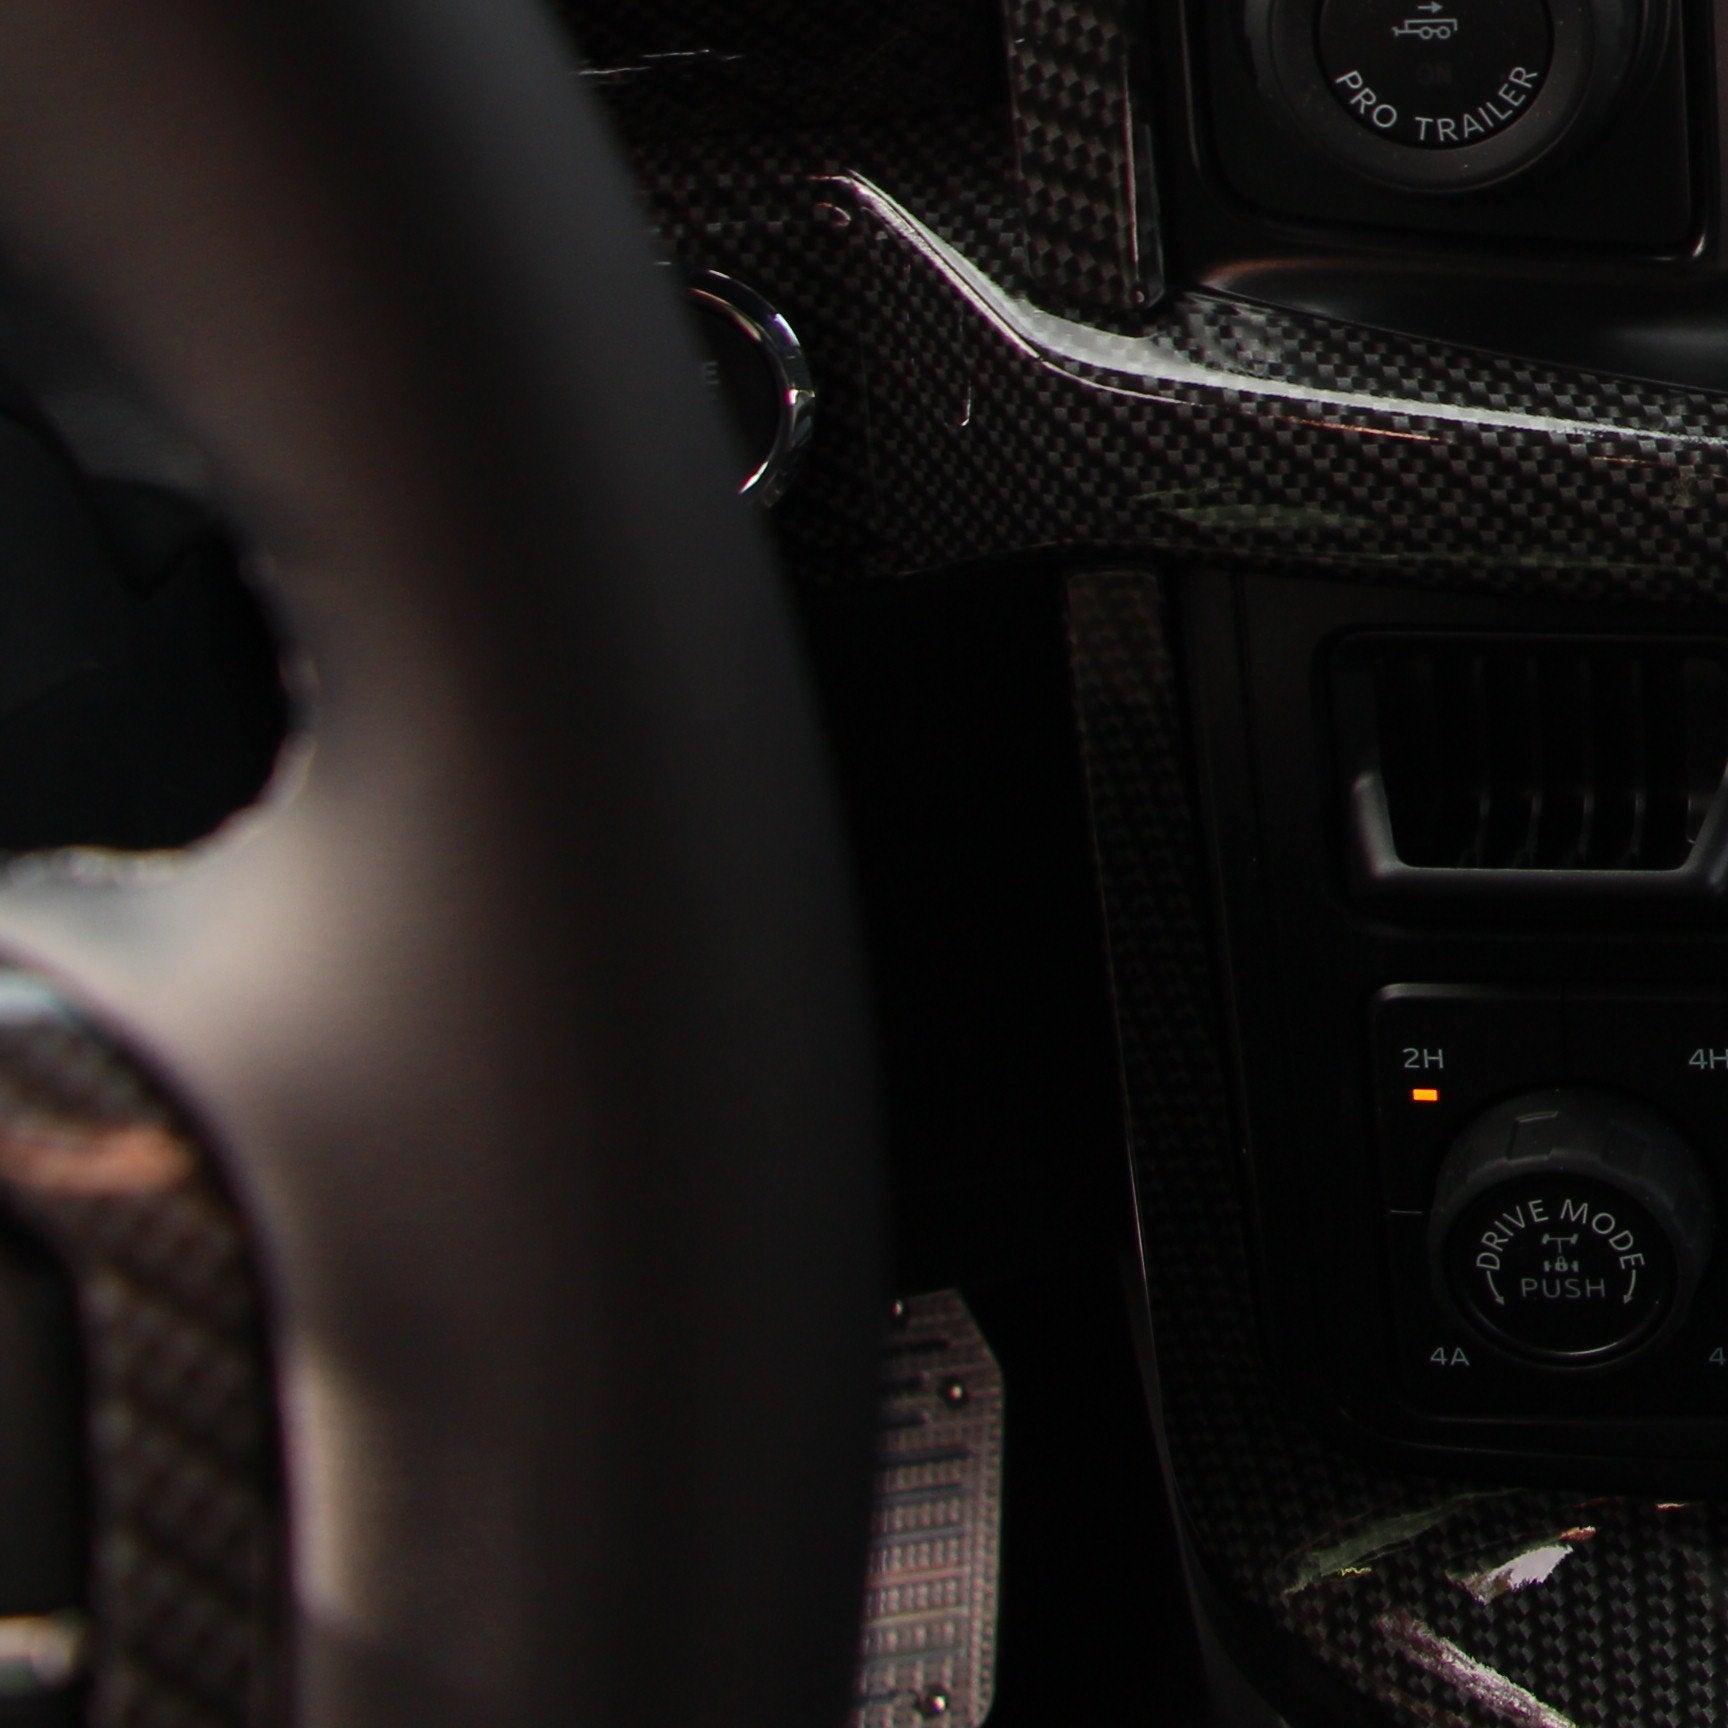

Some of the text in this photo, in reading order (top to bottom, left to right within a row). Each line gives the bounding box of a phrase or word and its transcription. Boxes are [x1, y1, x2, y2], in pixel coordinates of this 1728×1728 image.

[1334, 65, 1539, 142] PRO TRAILER
[1403, 1048, 1444, 1069] 2H
[1475, 1198, 1646, 1270] DRIVE MODE
[1520, 1278, 1606, 1299] PUSH
[1429, 1346, 1471, 1367] 4A
